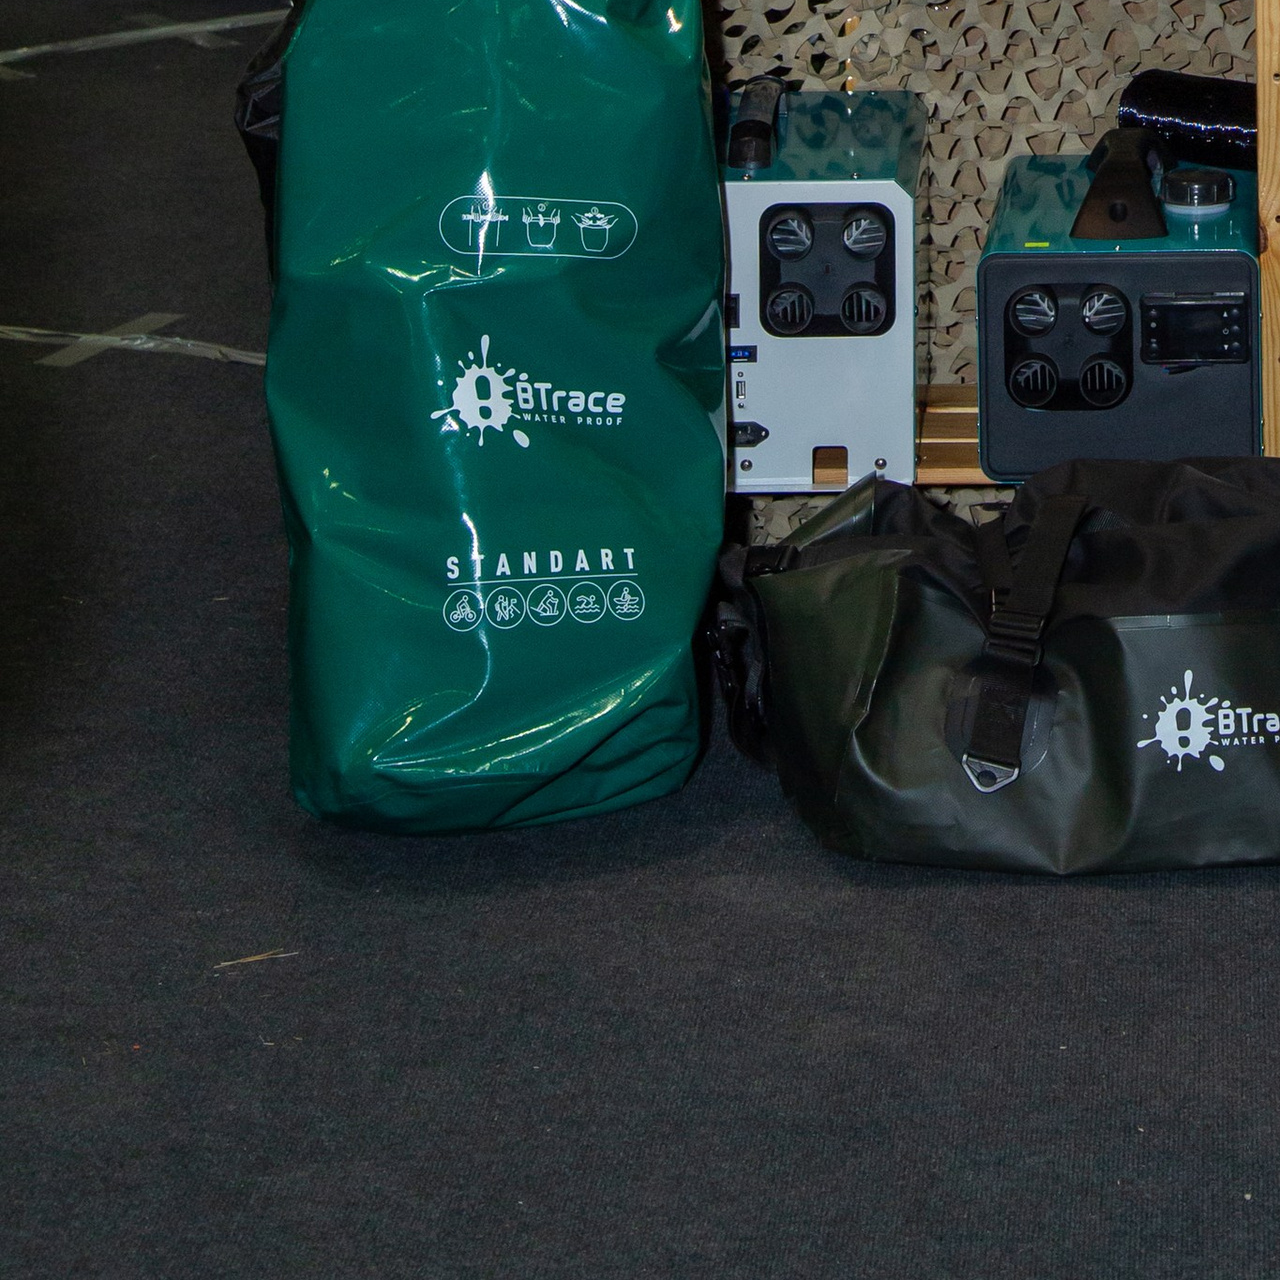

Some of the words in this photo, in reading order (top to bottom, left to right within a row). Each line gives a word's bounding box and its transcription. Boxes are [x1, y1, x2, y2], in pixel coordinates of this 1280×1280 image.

[515, 381, 627, 414] BTrace
[522, 412, 567, 425] WATER
[577, 415, 624, 427] PROOF
[446, 548, 636, 580] STANDART
[1220, 735, 1266, 747] WATER
